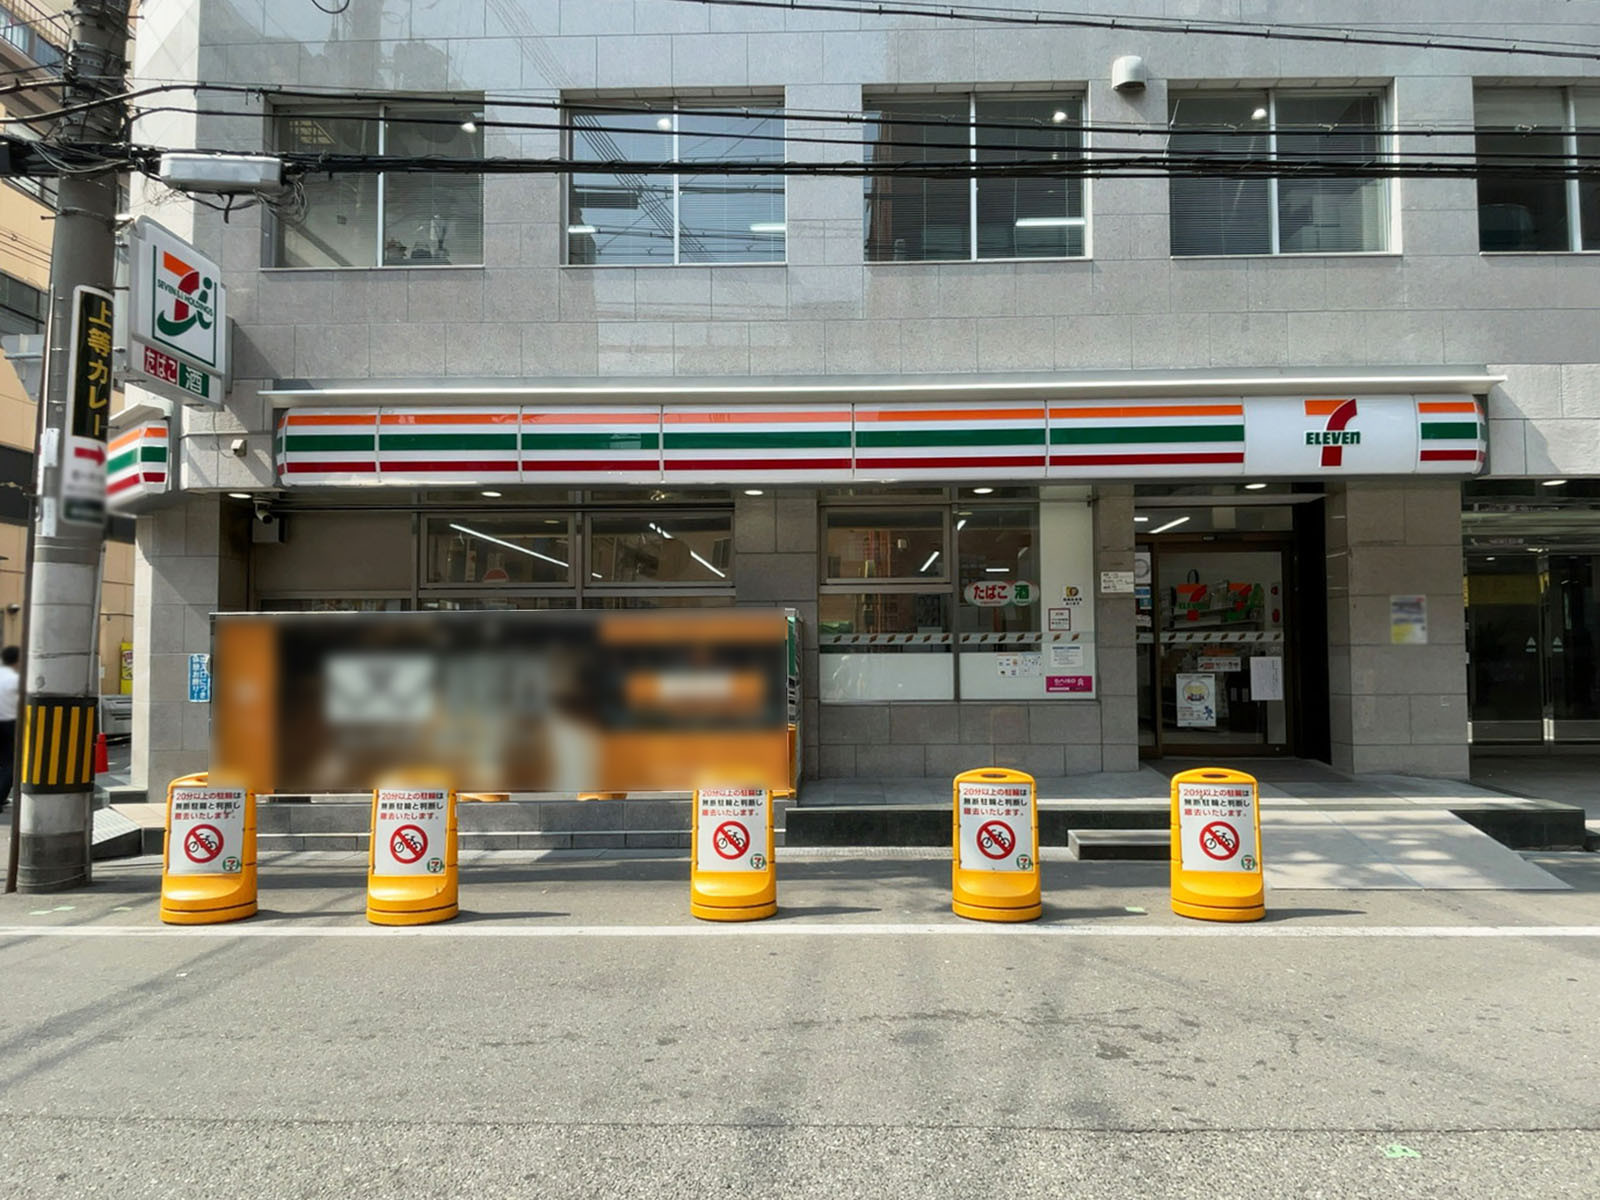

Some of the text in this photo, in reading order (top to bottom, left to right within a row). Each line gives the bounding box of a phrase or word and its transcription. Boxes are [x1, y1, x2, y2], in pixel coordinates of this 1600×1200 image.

[88, 301, 112, 436] 上等カレー
[145, 349, 177, 383] たばこ
[186, 366, 203, 394] 酒
[1304, 398, 1358, 467] 7
[974, 584, 1009, 600] たばこ
[1014, 584, 1030, 600] 酒
